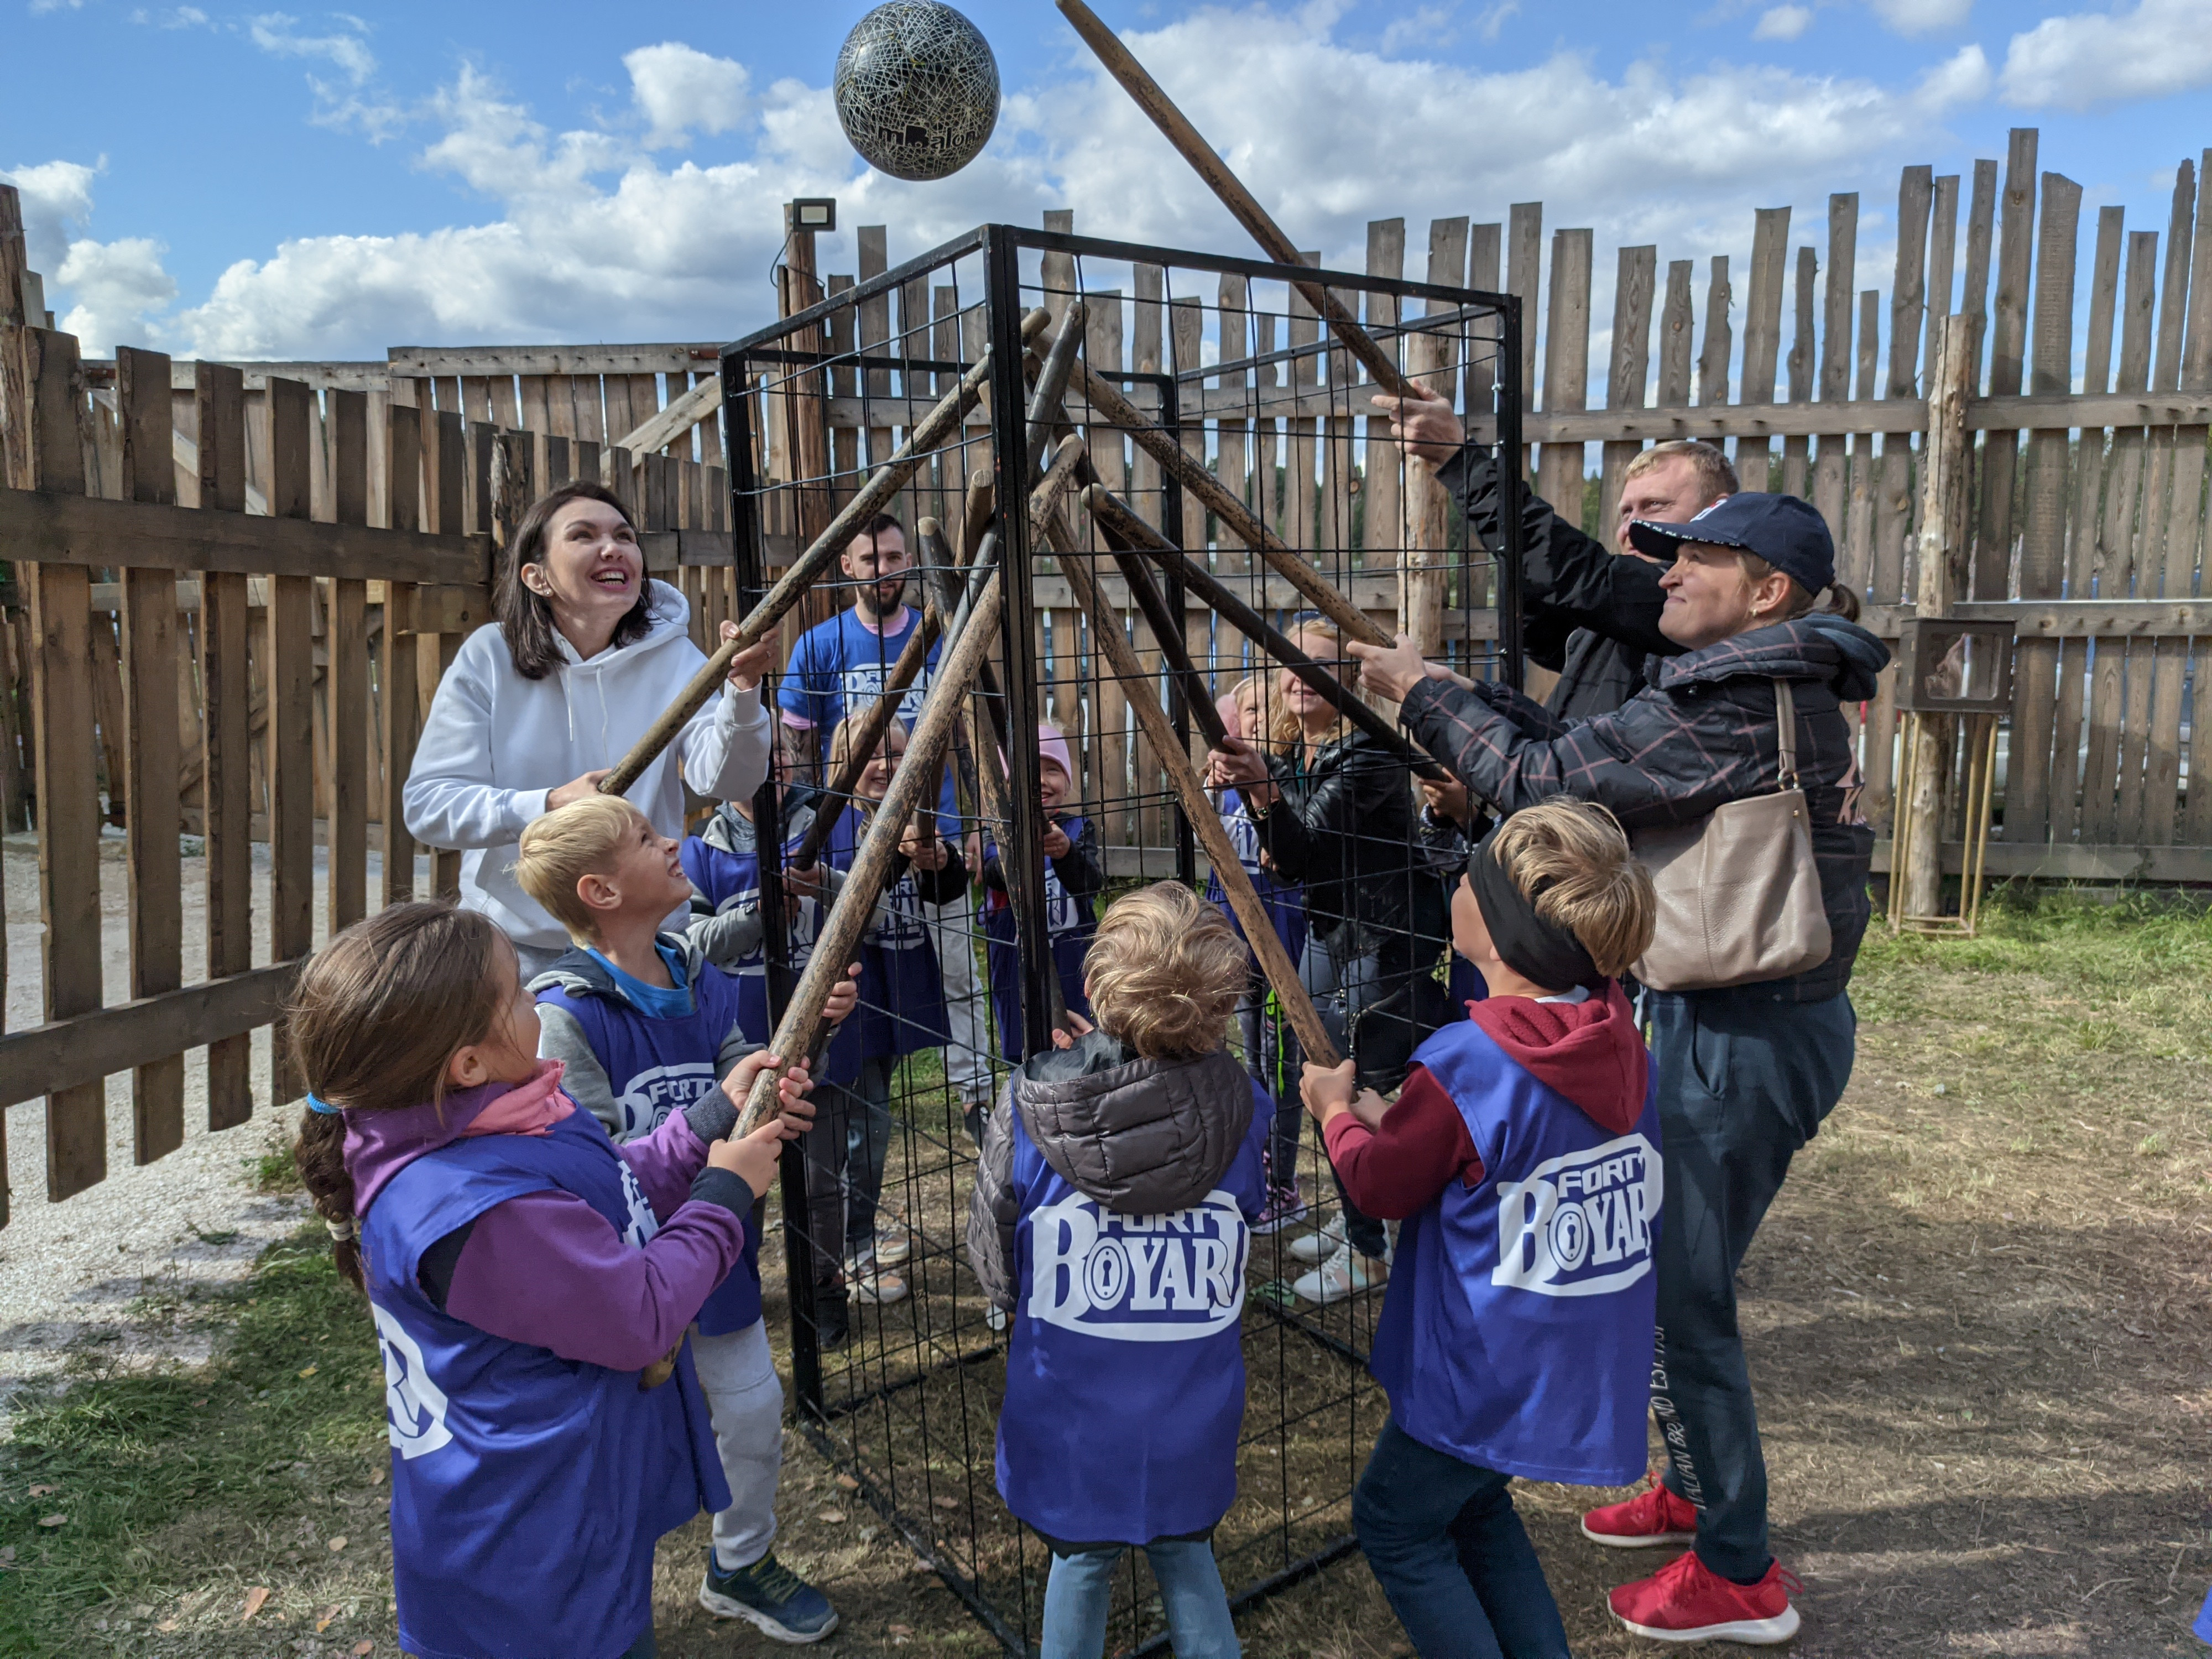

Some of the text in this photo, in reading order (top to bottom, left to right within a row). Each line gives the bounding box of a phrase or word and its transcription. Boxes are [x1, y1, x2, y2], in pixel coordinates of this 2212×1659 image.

[1557, 1152, 1641, 1198] FORT
[1098, 1205, 1211, 1233] FORT
[1491, 1178, 1653, 1286] BOYAR
[1027, 1197, 1245, 1324] BOYAR
